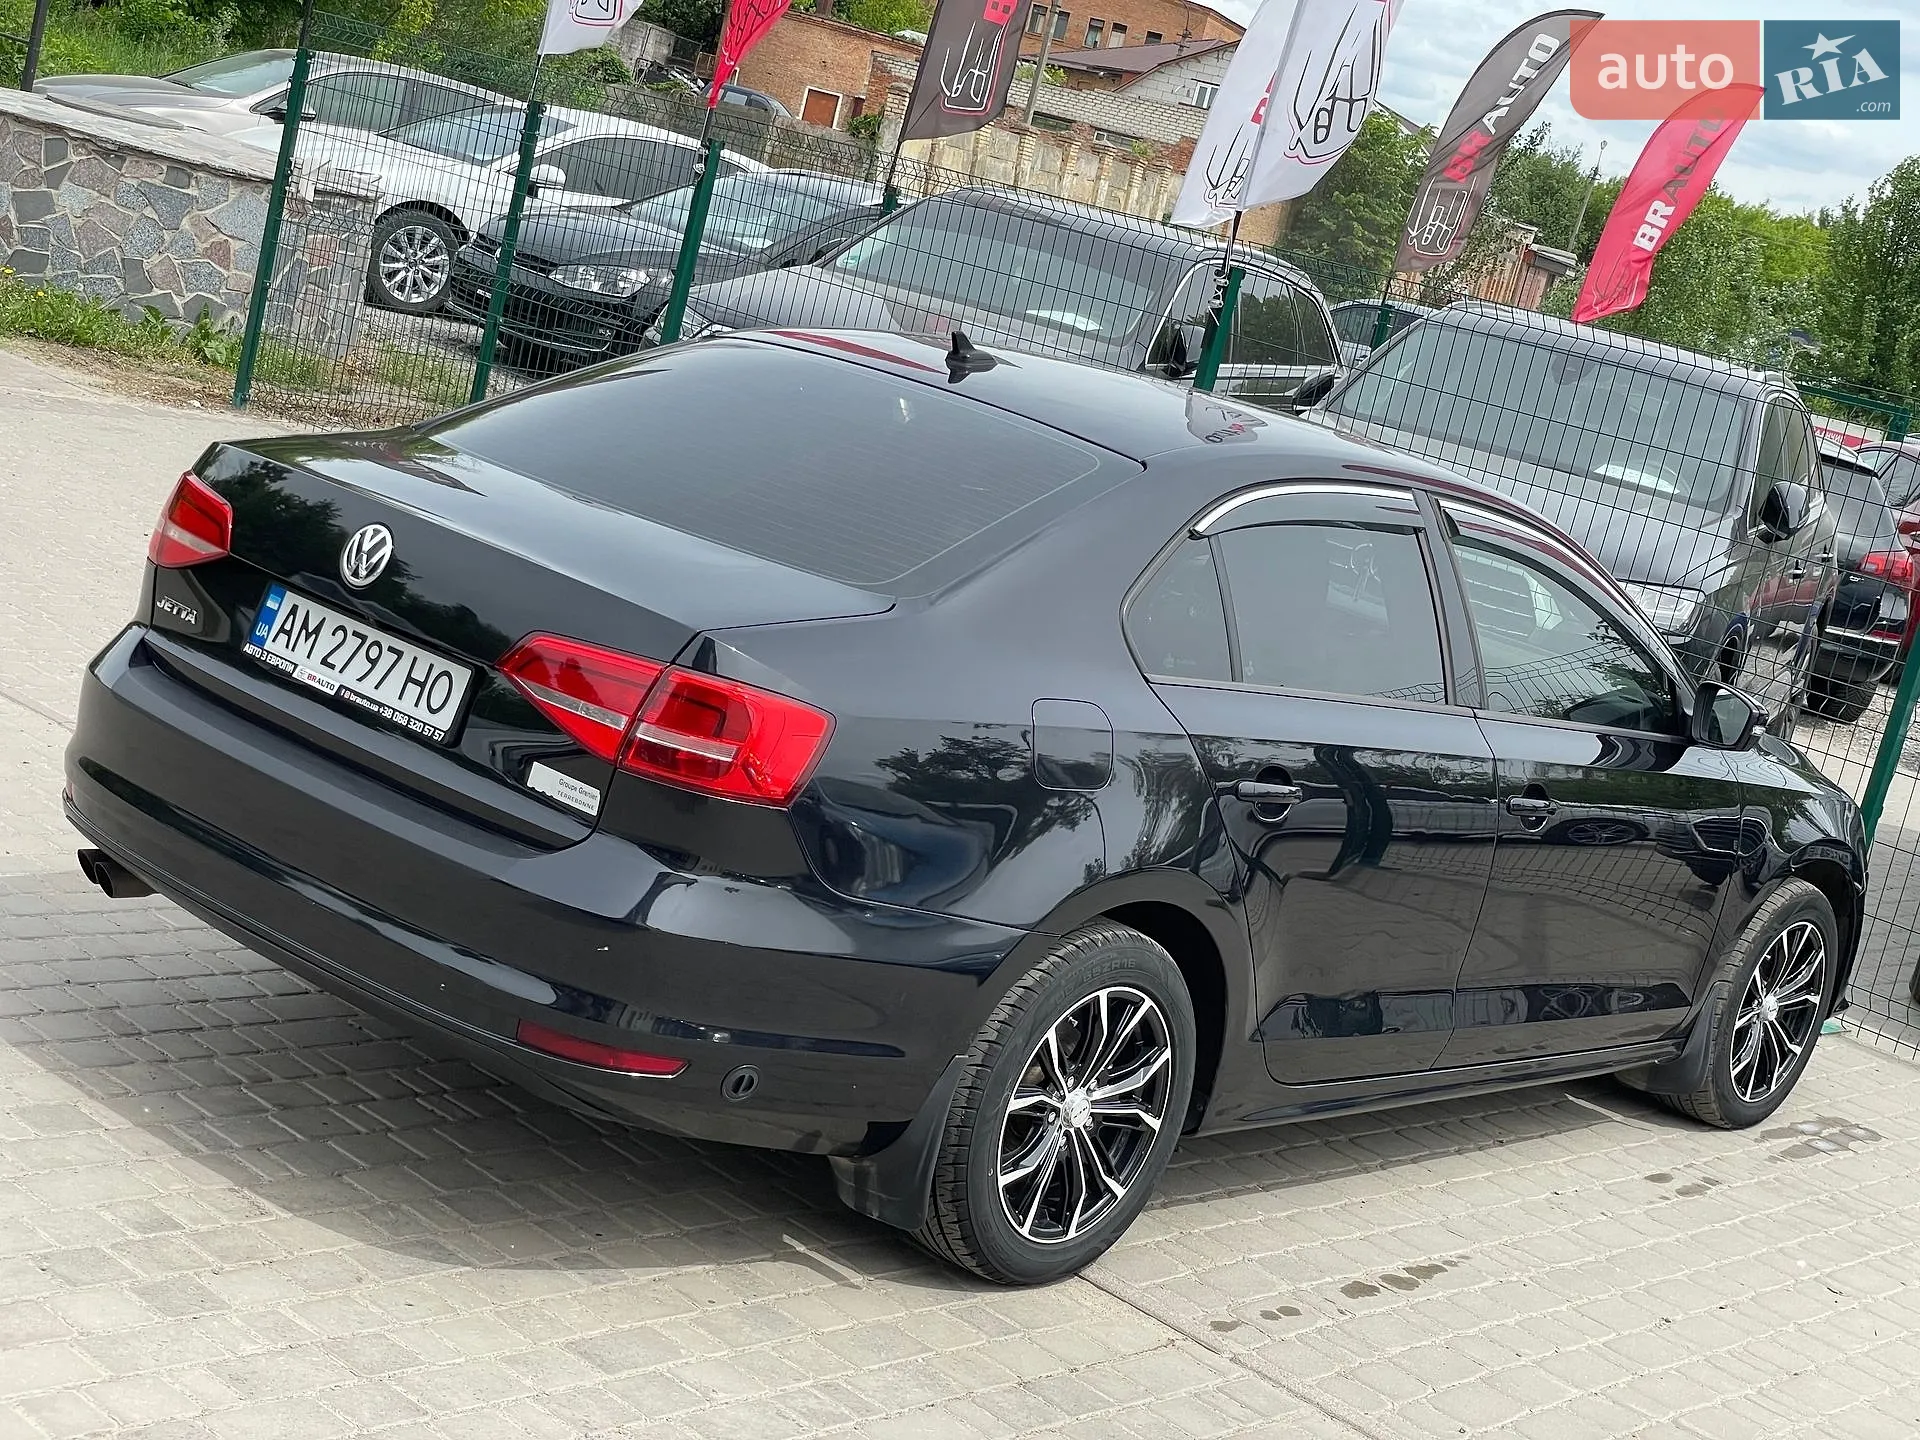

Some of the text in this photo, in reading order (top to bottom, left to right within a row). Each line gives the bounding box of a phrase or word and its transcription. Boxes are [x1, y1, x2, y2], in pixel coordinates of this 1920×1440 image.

[1442, 32, 1560, 184] BRAUTO
[156, 595, 199, 626] JETTA
[255, 622, 269, 641] UA
[243, 643, 262, 659] АВТО
[271, 603, 454, 715] AM 2797 HO
[306, 673, 336, 691] BRAUTO
[349, 692, 380, 712] brauto.ua
[379, 705, 446, 742] +38 068 320 57 57
[558, 778, 578, 792] Groupe
[557, 790, 595, 811] TERREBONNE
